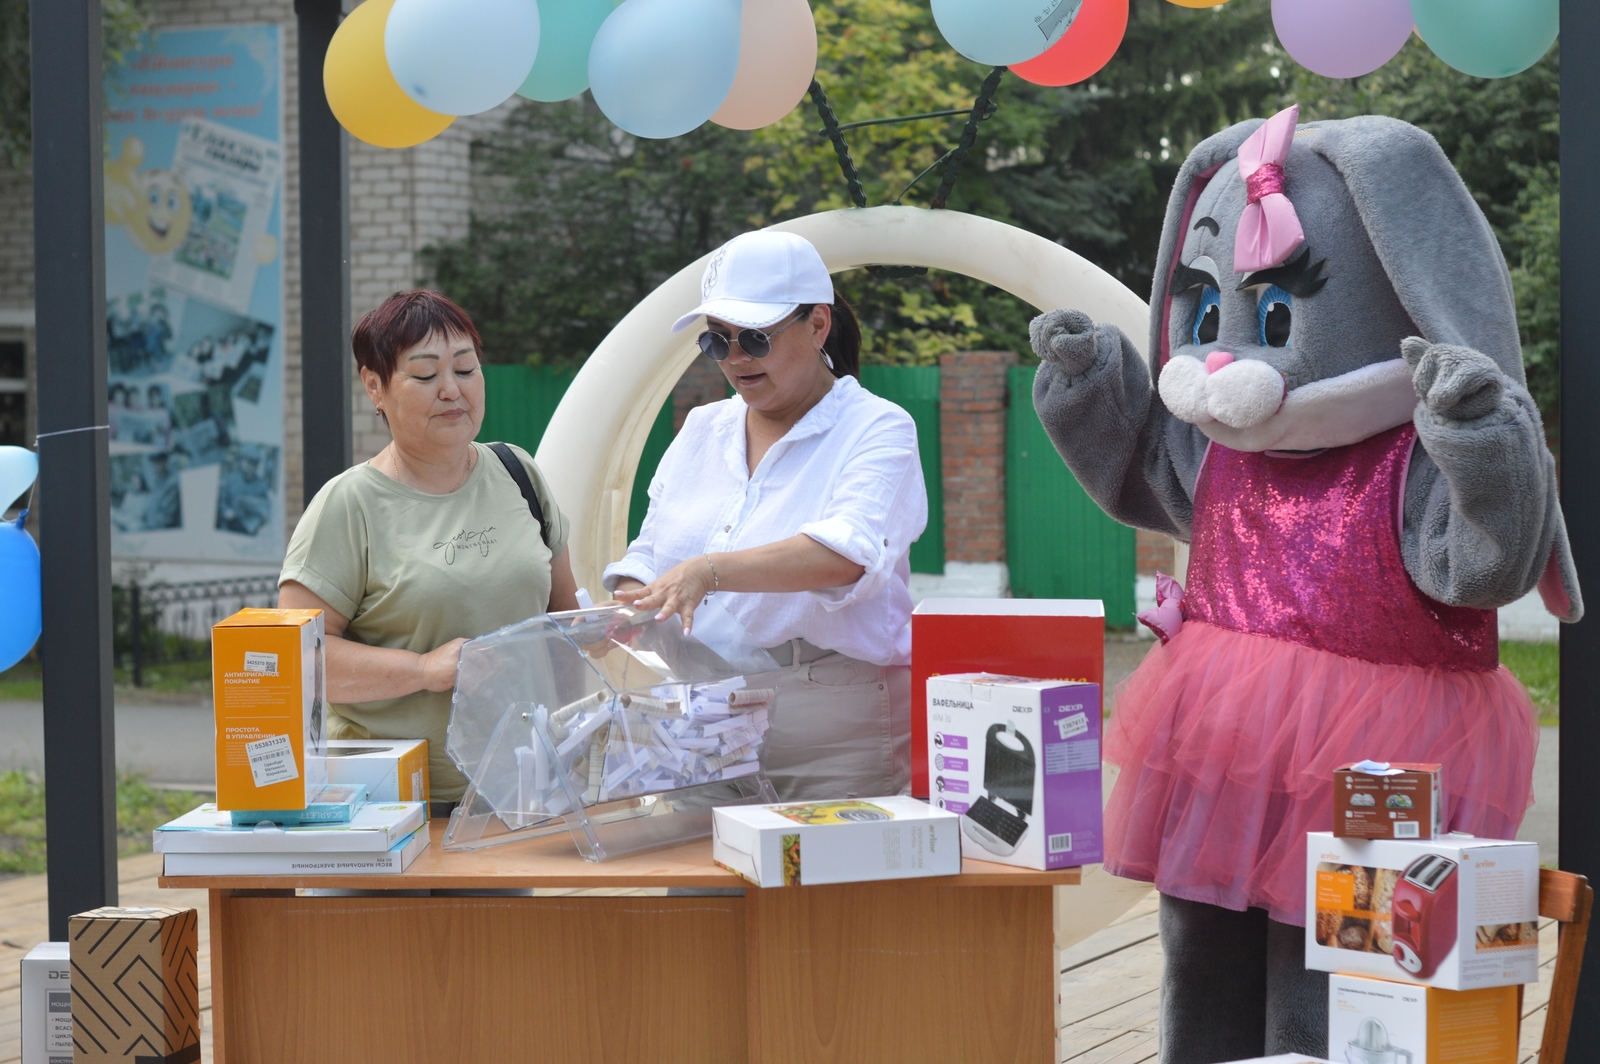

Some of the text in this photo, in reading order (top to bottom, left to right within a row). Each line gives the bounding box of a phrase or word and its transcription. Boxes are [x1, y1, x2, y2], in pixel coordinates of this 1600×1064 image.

[932, 698, 974, 710] ВАФЕЛЬНИЦА
[1058, 703, 1084, 713] DEXP
[1012, 705, 1033, 714] DEXP
[300, 810, 343, 820] SCARLETT
